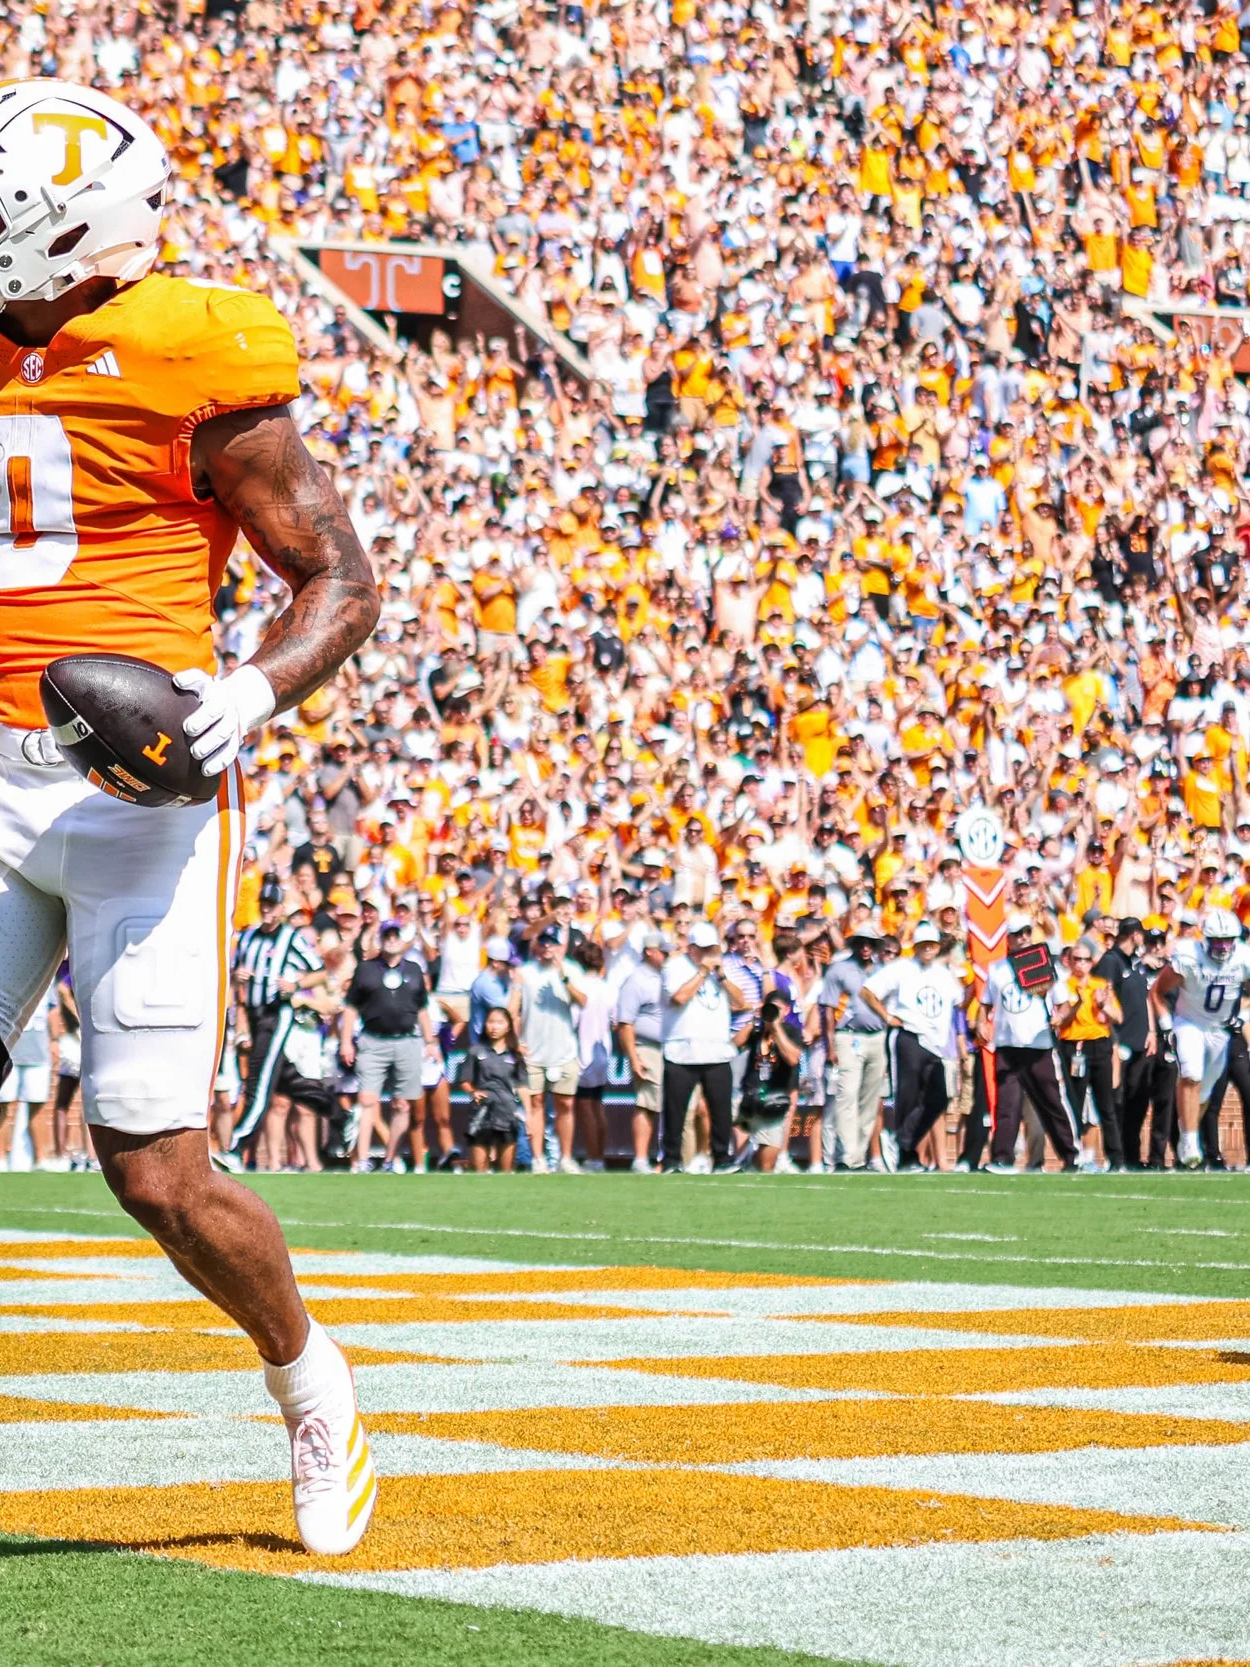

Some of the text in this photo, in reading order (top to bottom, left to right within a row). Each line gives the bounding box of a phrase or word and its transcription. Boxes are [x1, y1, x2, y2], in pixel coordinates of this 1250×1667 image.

[32, 113, 109, 186] T
[442, 272, 462, 298] C
[22, 355, 43, 381] SEC
[141, 731, 173, 767] T
[1014, 945, 1052, 988] 2
[1203, 984, 1226, 1014] 0
